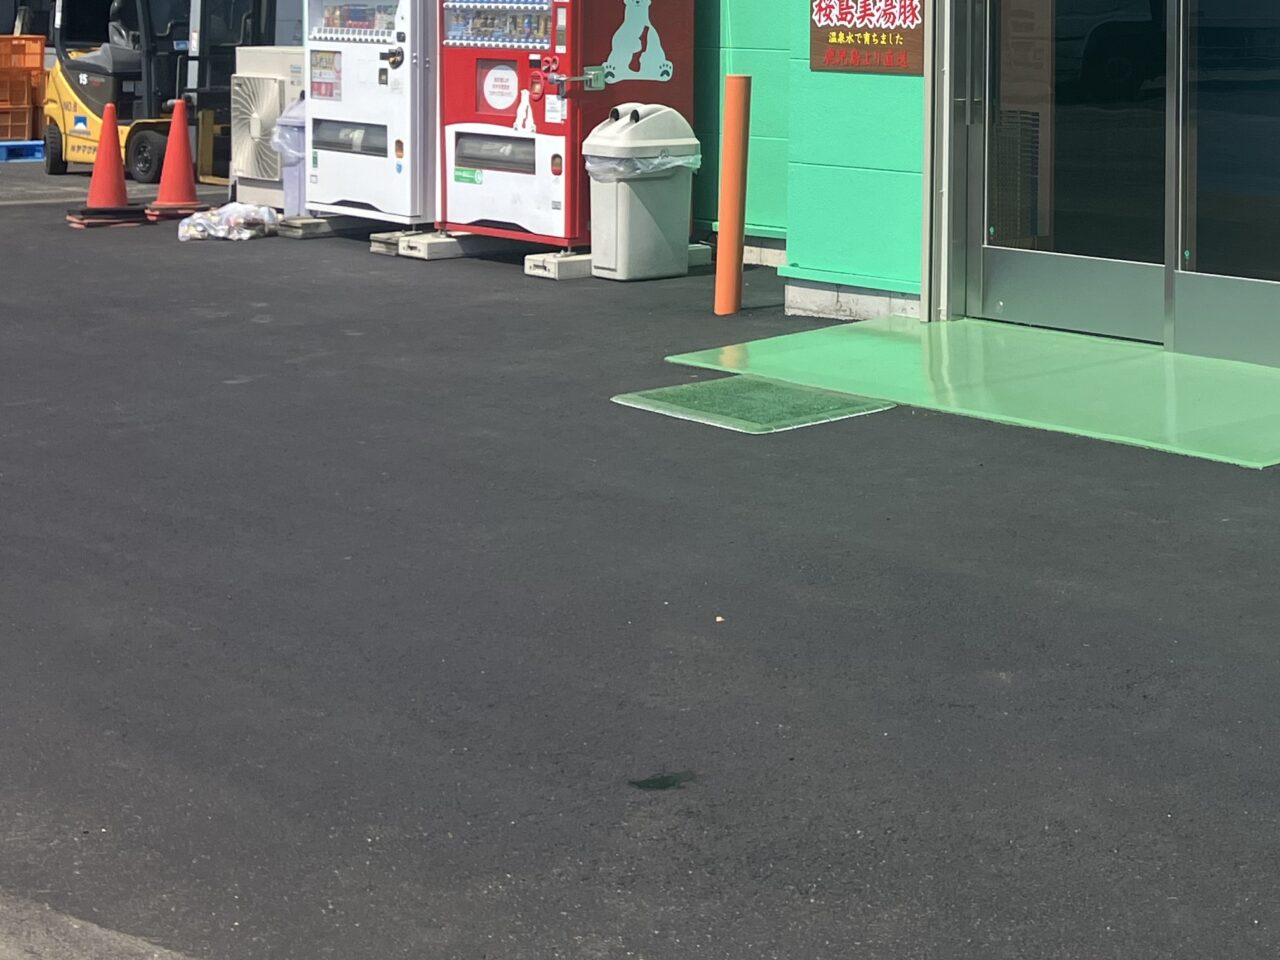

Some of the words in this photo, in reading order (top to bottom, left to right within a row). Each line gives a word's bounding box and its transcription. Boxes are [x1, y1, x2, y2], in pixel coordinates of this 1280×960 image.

[828, 31, 904, 45] 温泉水で育ちました
[79, 73, 88, 85] 15
